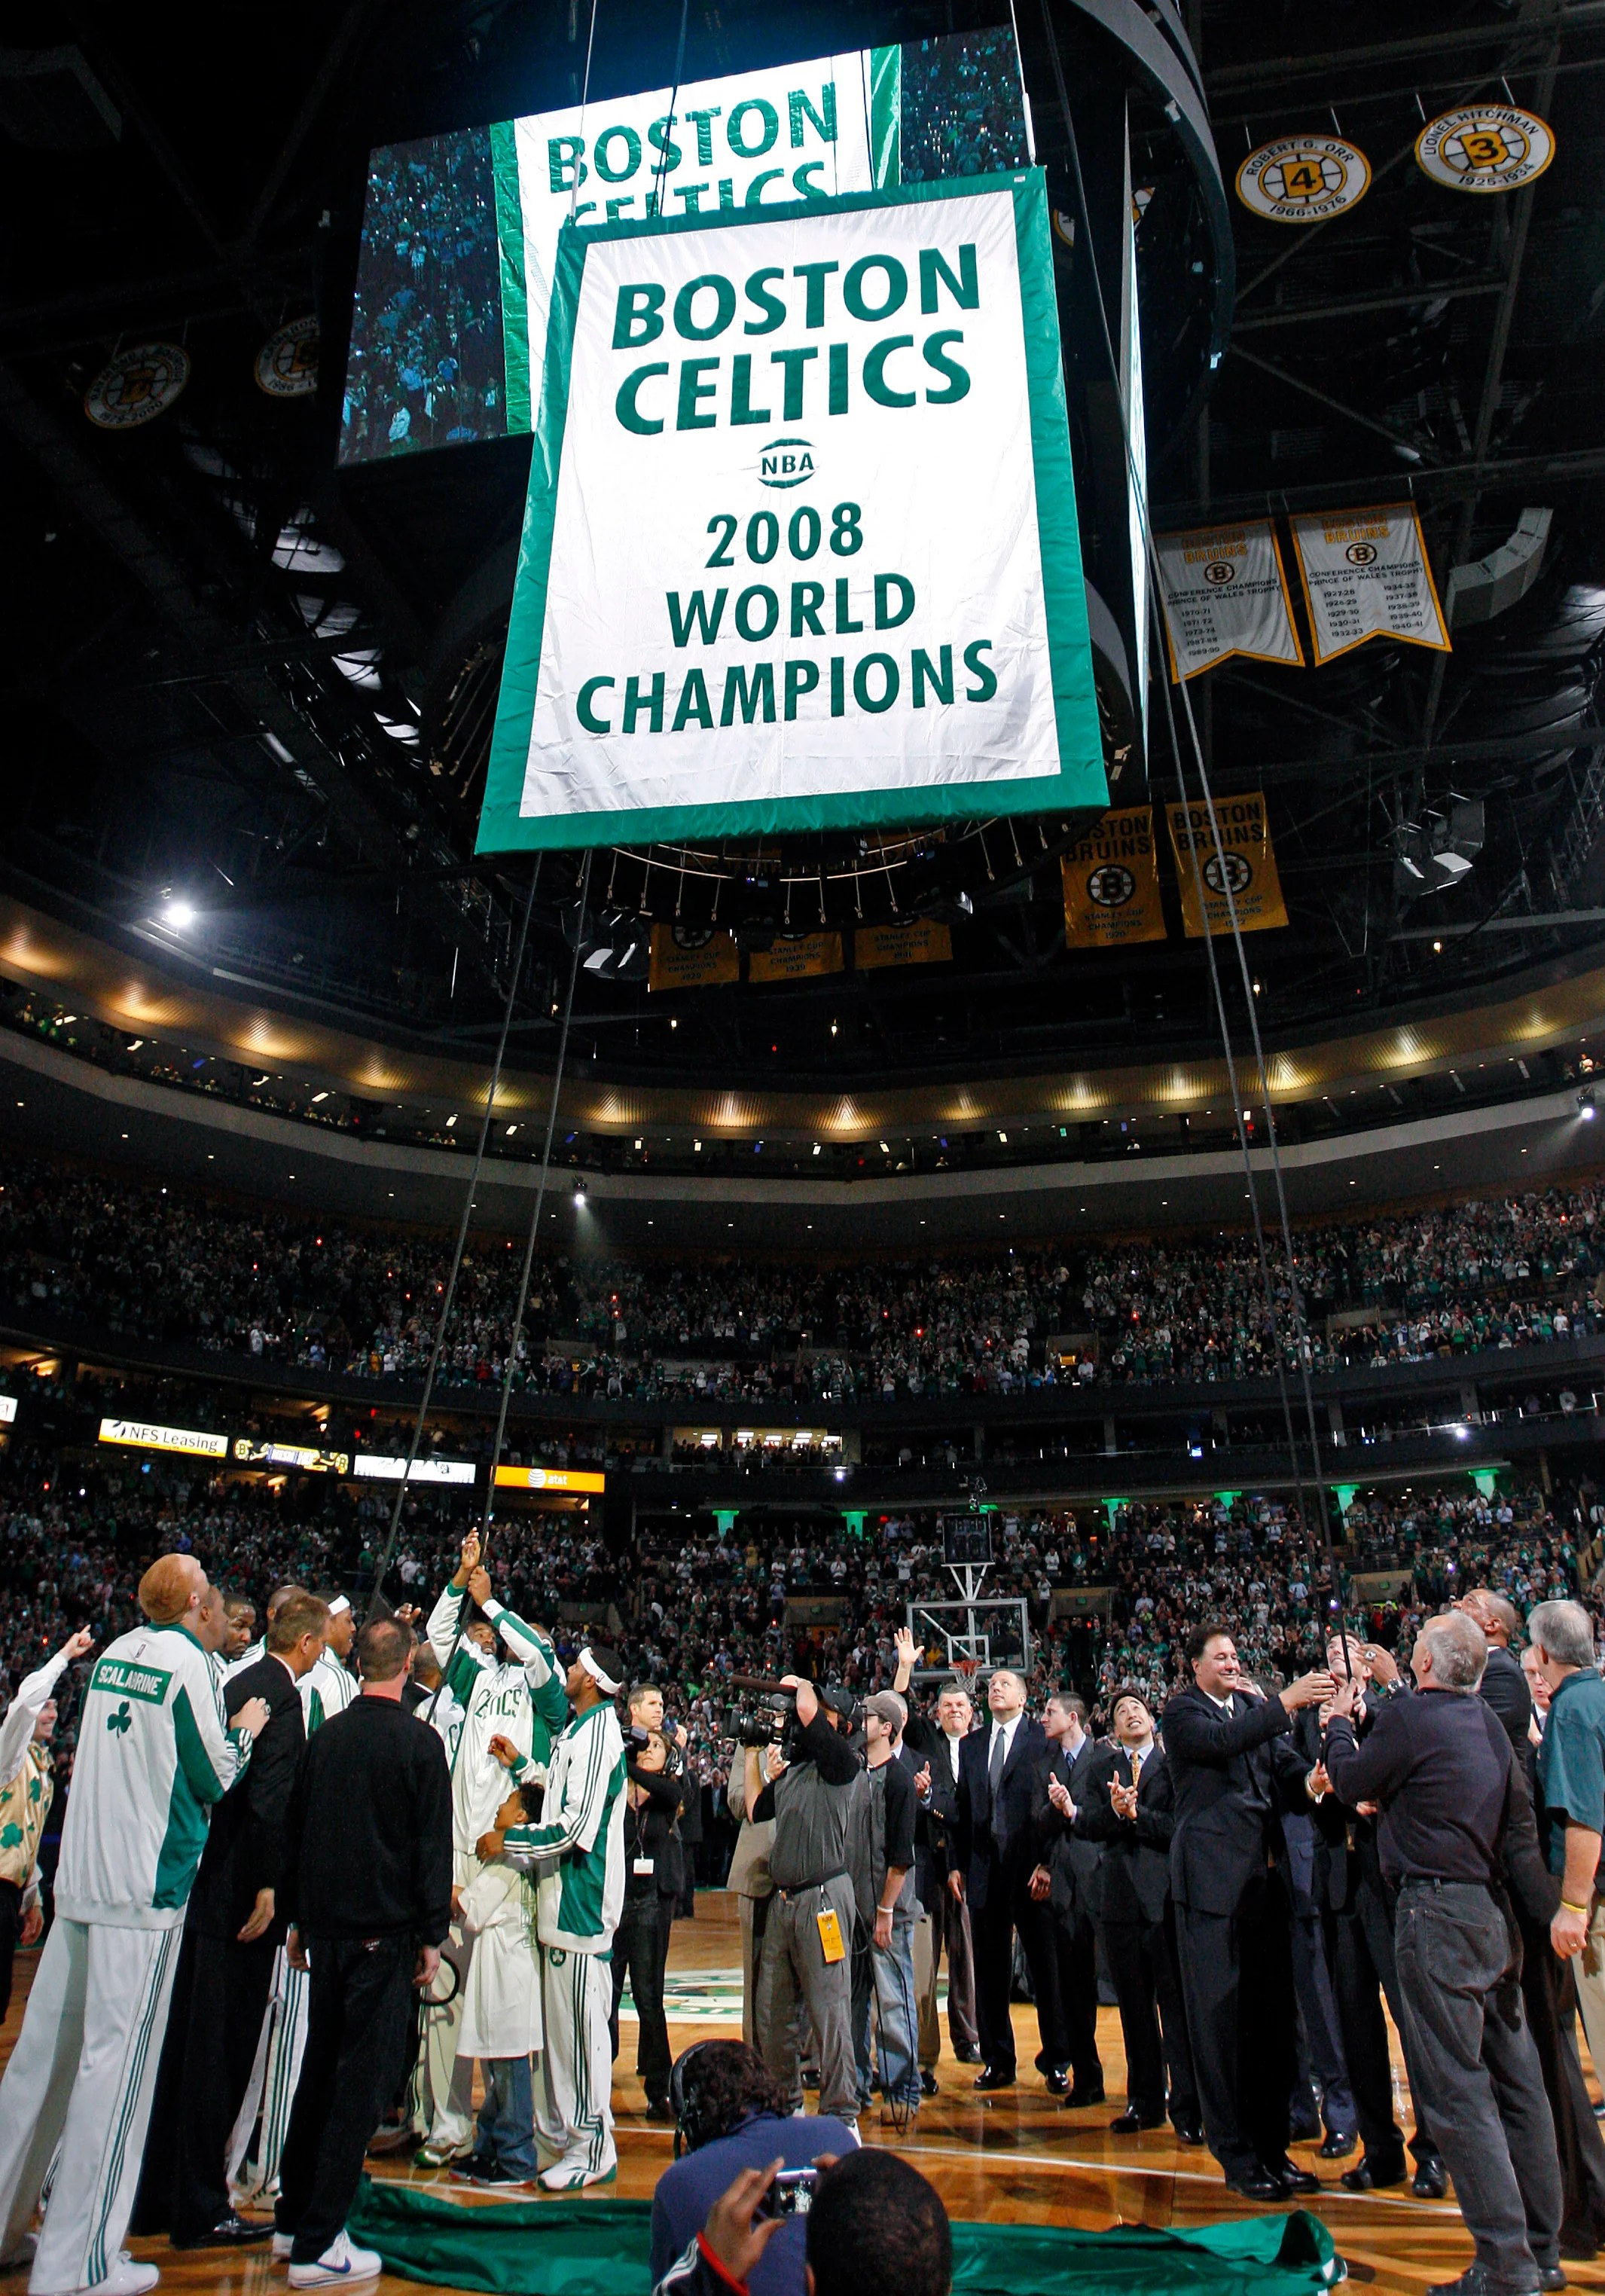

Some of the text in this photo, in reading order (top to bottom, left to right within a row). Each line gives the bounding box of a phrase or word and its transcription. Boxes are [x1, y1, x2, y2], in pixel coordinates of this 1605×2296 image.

[548, 81, 838, 194] BOSTON
[1423, 109, 1539, 155] LIONEL HITCHMAN
[1246, 142, 1296, 176] ROBERT
[1326, 143, 1355, 163] ORR
[1470, 138, 1499, 159] 3
[1290, 167, 1317, 188] 4
[1459, 163, 1536, 186] 1925-1934
[1270, 195, 1347, 216] 1966-1976
[612, 243, 980, 350] BOSTON
[615, 329, 971, 435] CELTICS
[761, 452, 815, 476] NBA
[705, 502, 863, 569] 2008
[1324, 526, 1390, 544] BRUINS
[1184, 542, 1248, 563] BRUINS
[1309, 560, 1420, 578] CONFERENCE CHAMPIONS
[1309, 578, 1338, 587] PRINCE
[1358, 572, 1387, 581] WALES
[1390, 567, 1423, 578] TROPHY
[1167, 579, 1277, 600] CONFERENCE CHAMPIONS
[1215, 591, 1244, 600] WALES
[1247, 585, 1281, 596] TROPHY
[666, 573, 916, 648] WORLD
[575, 640, 999, 734] CHAMPIONS
[1088, 815, 1148, 839] STON
[1174, 802, 1261, 829] BOSTON
[1177, 823, 1264, 850] BRUINS
[1066, 836, 1151, 863] BRUINS
[130, 1426, 159, 1442] NFS
[163, 1431, 218, 1453] Leasing
